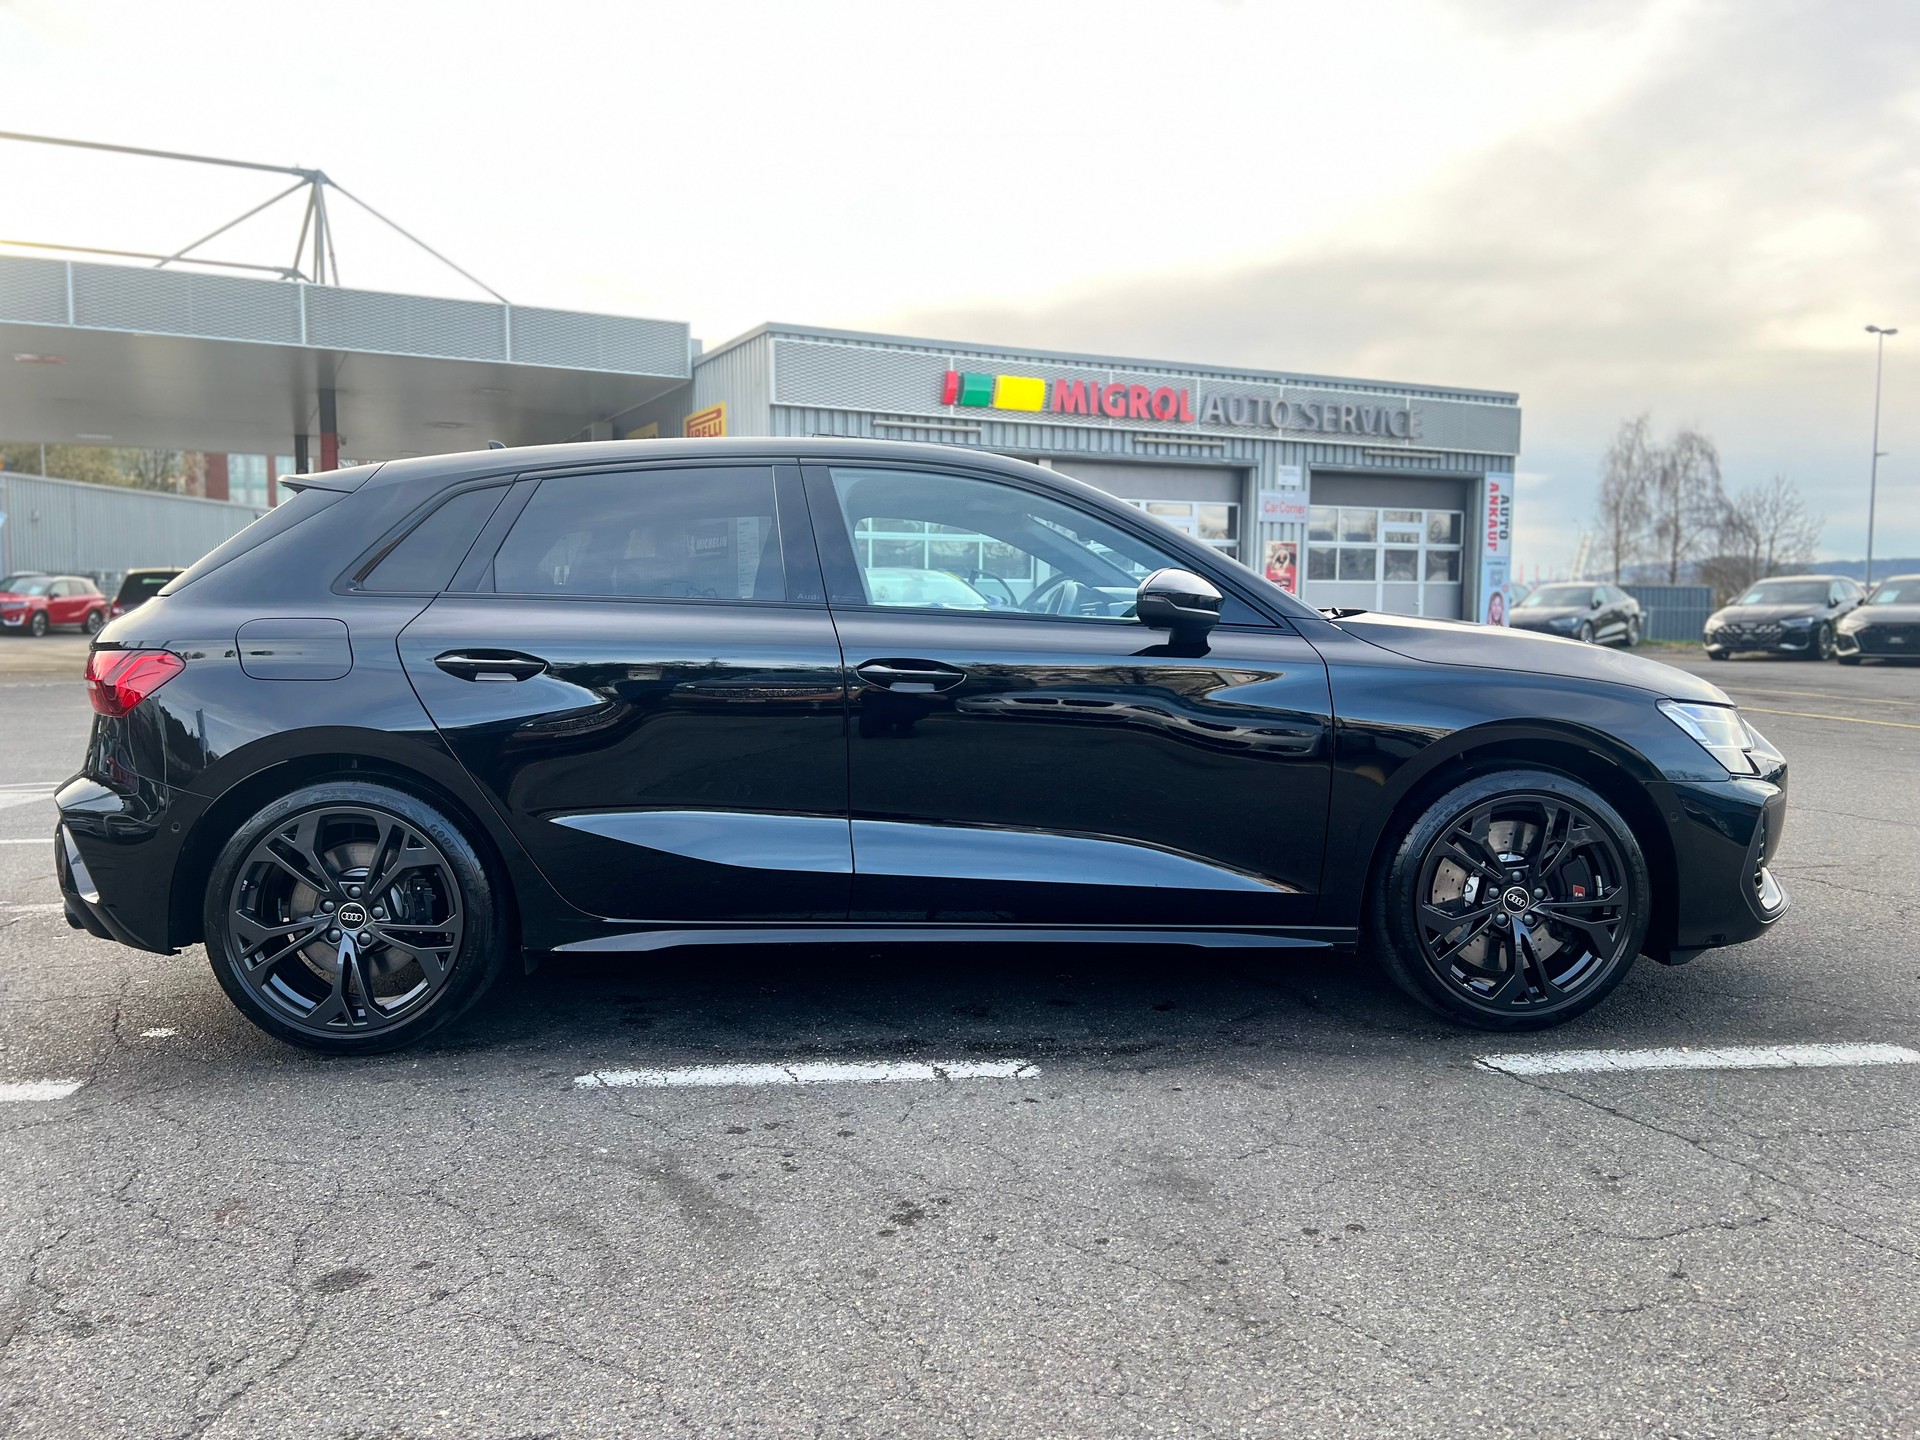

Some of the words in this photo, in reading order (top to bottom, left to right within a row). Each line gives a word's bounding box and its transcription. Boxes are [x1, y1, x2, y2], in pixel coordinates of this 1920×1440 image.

[1053, 378, 1195, 423] MIGROL
[1200, 393, 1293, 430] AUTO
[1303, 400, 1424, 440] SERVICE
[1487, 482, 1500, 552] ANKAUF
[1499, 494, 1510, 540] AUTO
[695, 534, 728, 550] MICHELIN
[797, 592, 820, 601] Audi
